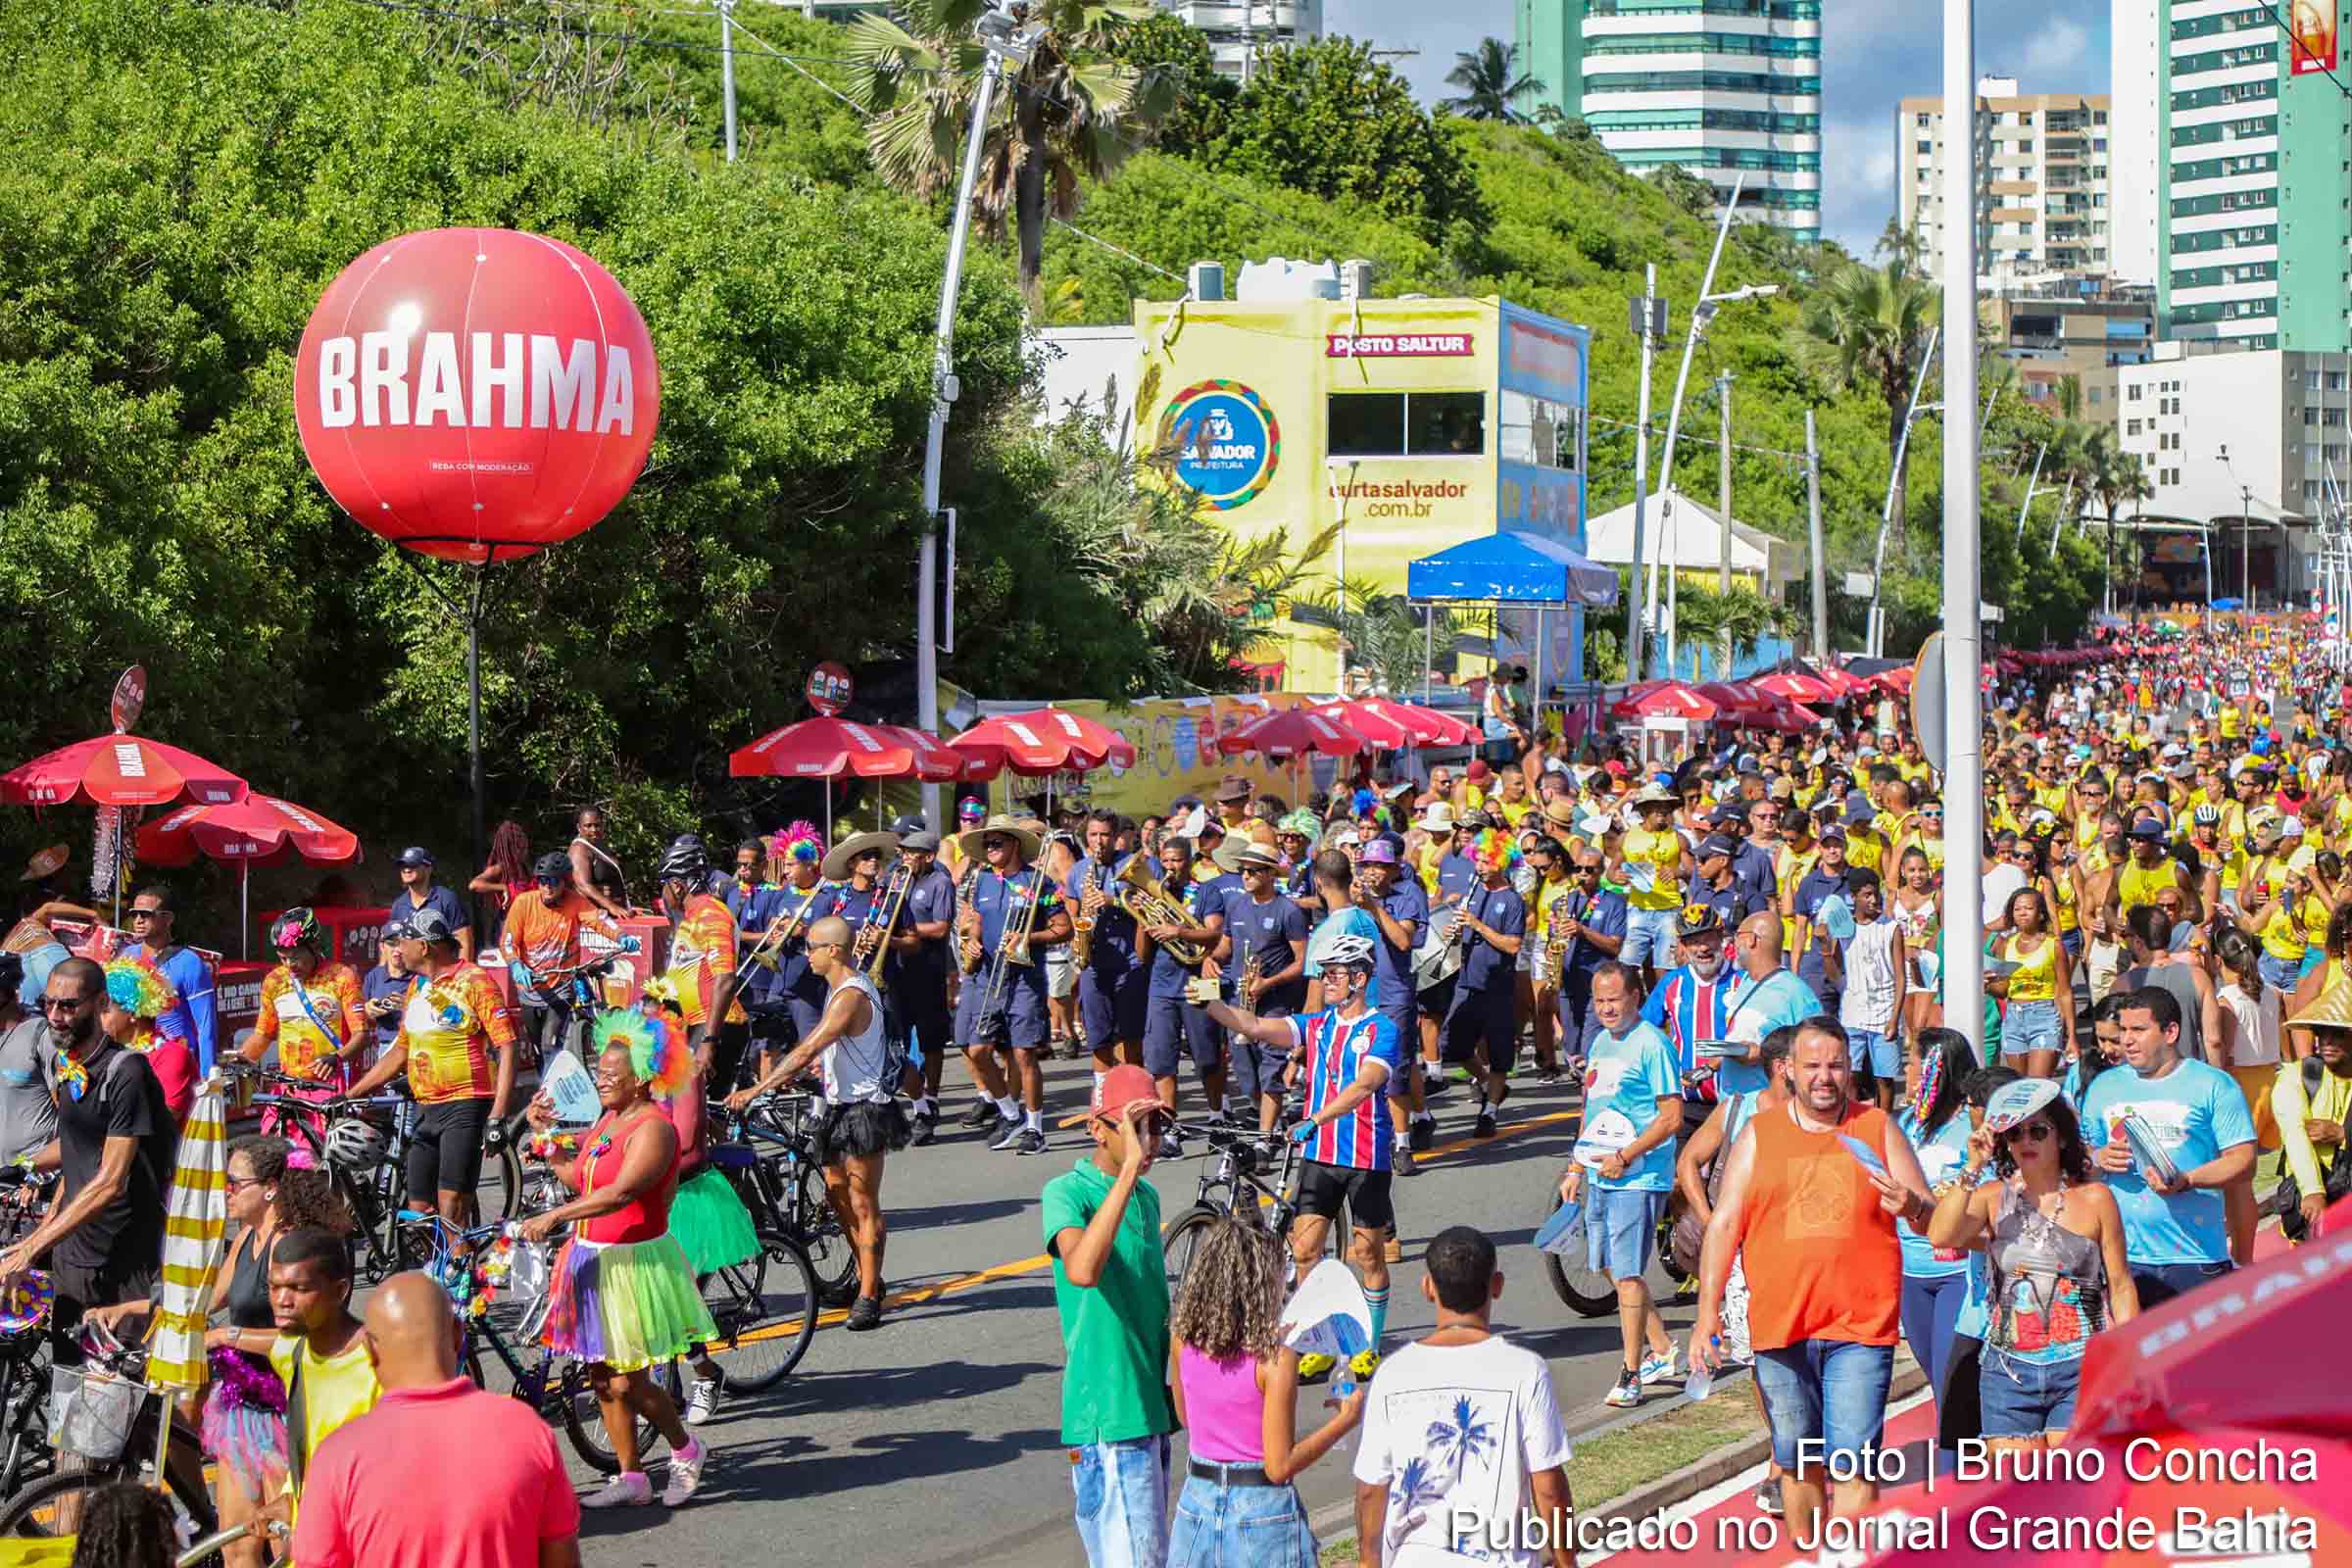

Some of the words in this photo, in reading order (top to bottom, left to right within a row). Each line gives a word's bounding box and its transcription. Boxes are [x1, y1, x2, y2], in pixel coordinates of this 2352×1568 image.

[1396, 336, 1465, 352] SALTUR
[318, 331, 634, 436] BRAHMA
[1181, 445, 1255, 460] SAVADOR
[1329, 479, 1467, 498] curtasalvador
[1364, 500, 1433, 517] .com.br
[224, 844, 258, 855] BRAMA
